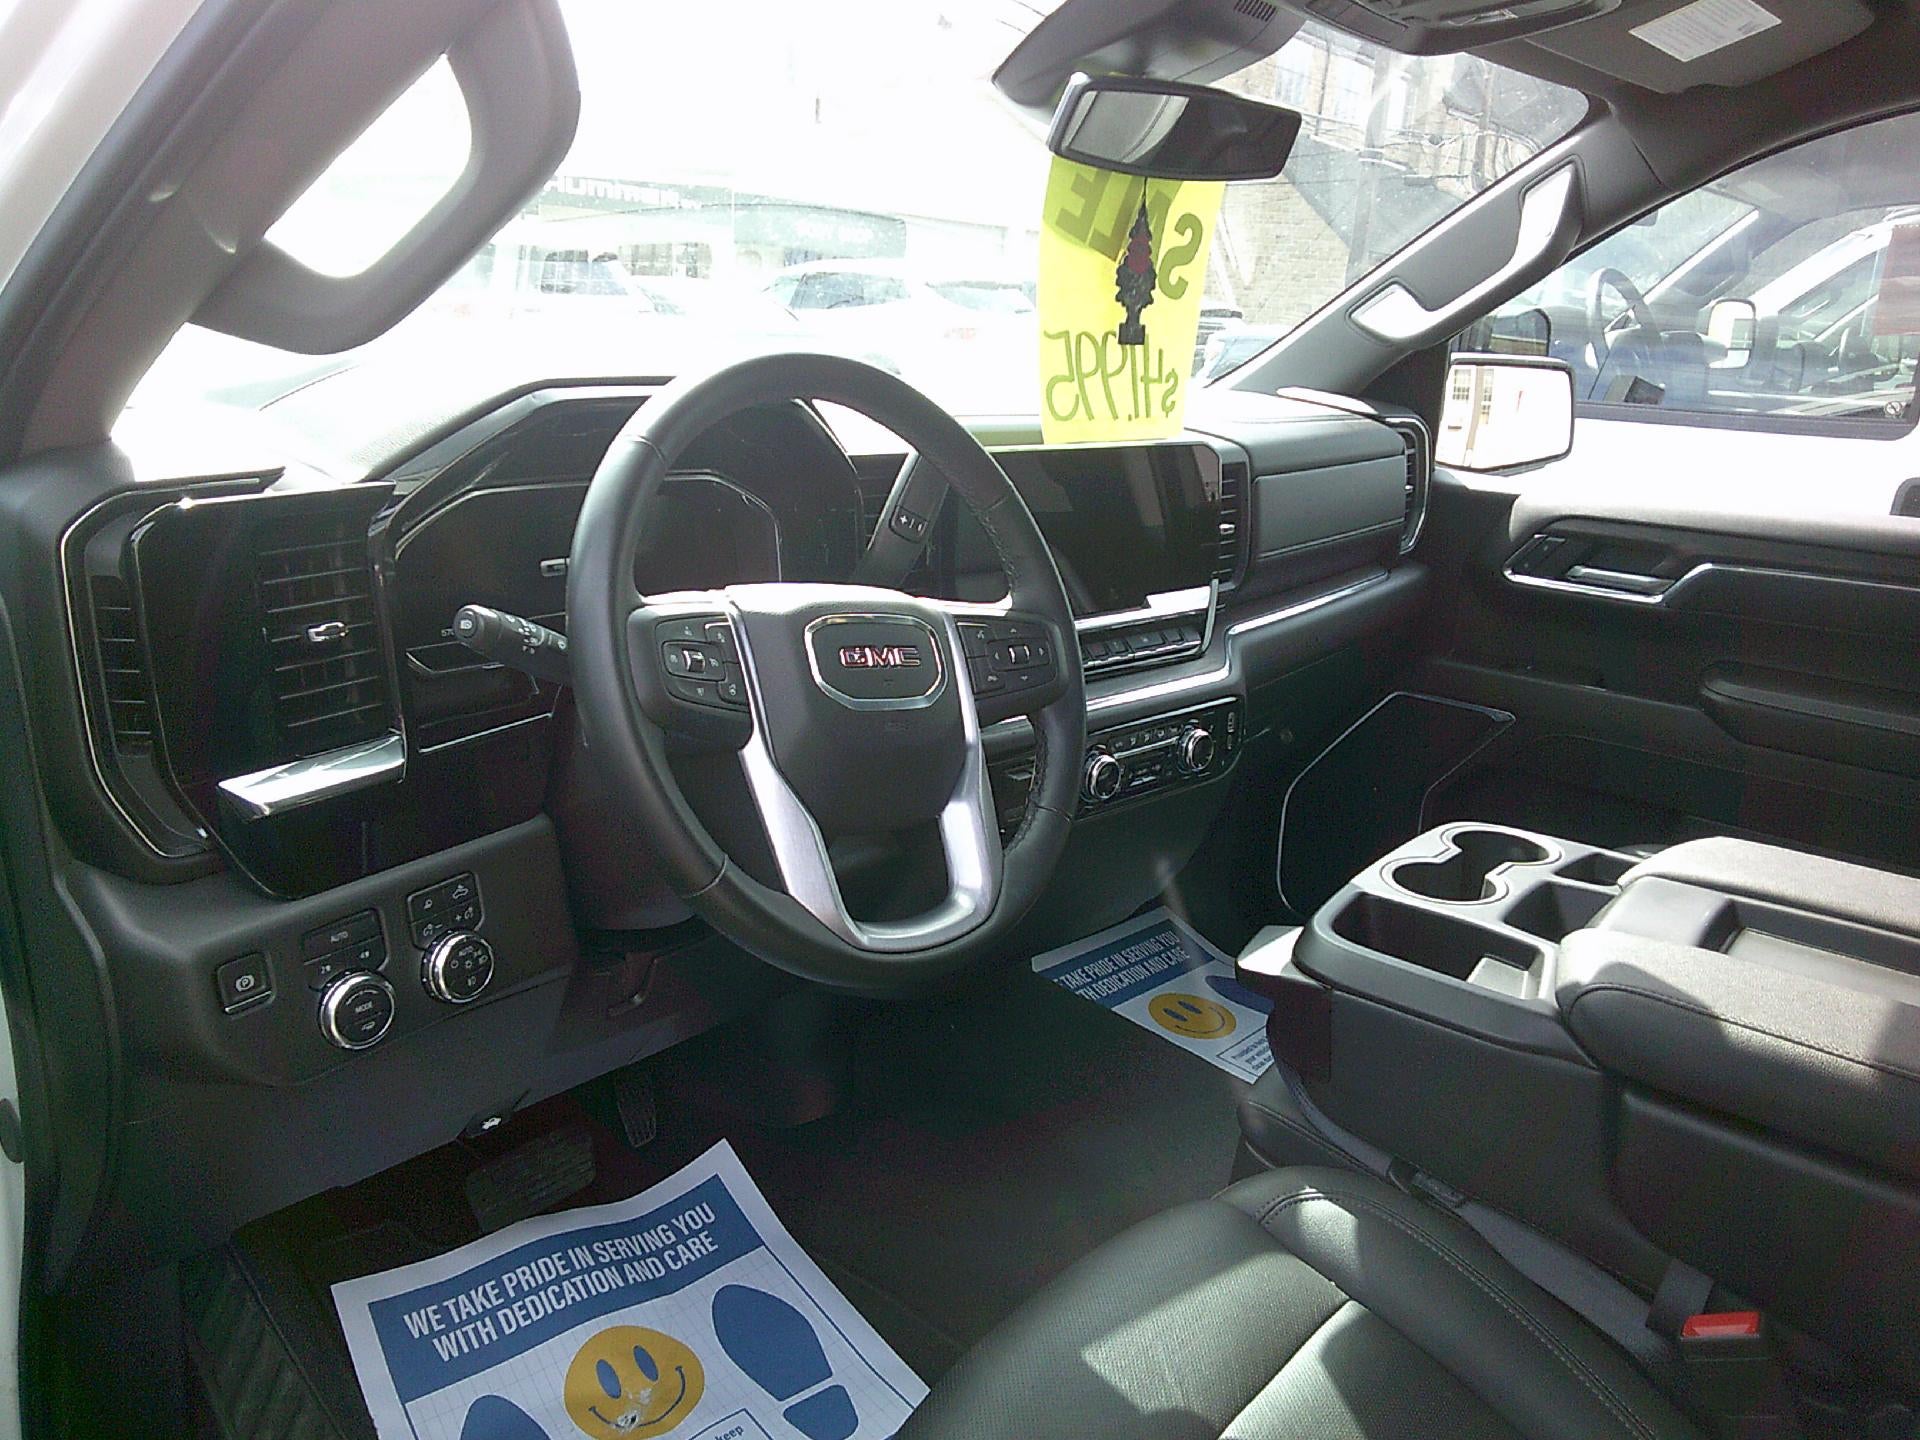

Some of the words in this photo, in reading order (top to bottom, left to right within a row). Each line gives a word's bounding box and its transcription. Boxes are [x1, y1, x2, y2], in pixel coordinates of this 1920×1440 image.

[839, 645, 921, 668] GMC
[1062, 969, 1091, 989] TAKE
[1084, 957, 1119, 977] PRIDE
[1122, 937, 1163, 963] SERVING
[1156, 930, 1180, 949] YOU
[1095, 965, 1146, 997] DEDICATION
[1143, 954, 1169, 977] AND
[1163, 946, 1190, 966] CARE
[404, 1304, 446, 1339] WE
[442, 1280, 504, 1323] TAKE
[502, 1252, 571, 1298] PRIDE
[568, 1245, 597, 1270] IN
[594, 1224, 676, 1262] SERVING
[671, 1201, 716, 1236] YOU
[432, 1319, 498, 1362] WITH
[495, 1267, 625, 1335] DEDICATION
[624, 1256, 666, 1285] AND
[663, 1231, 718, 1270] CARE
